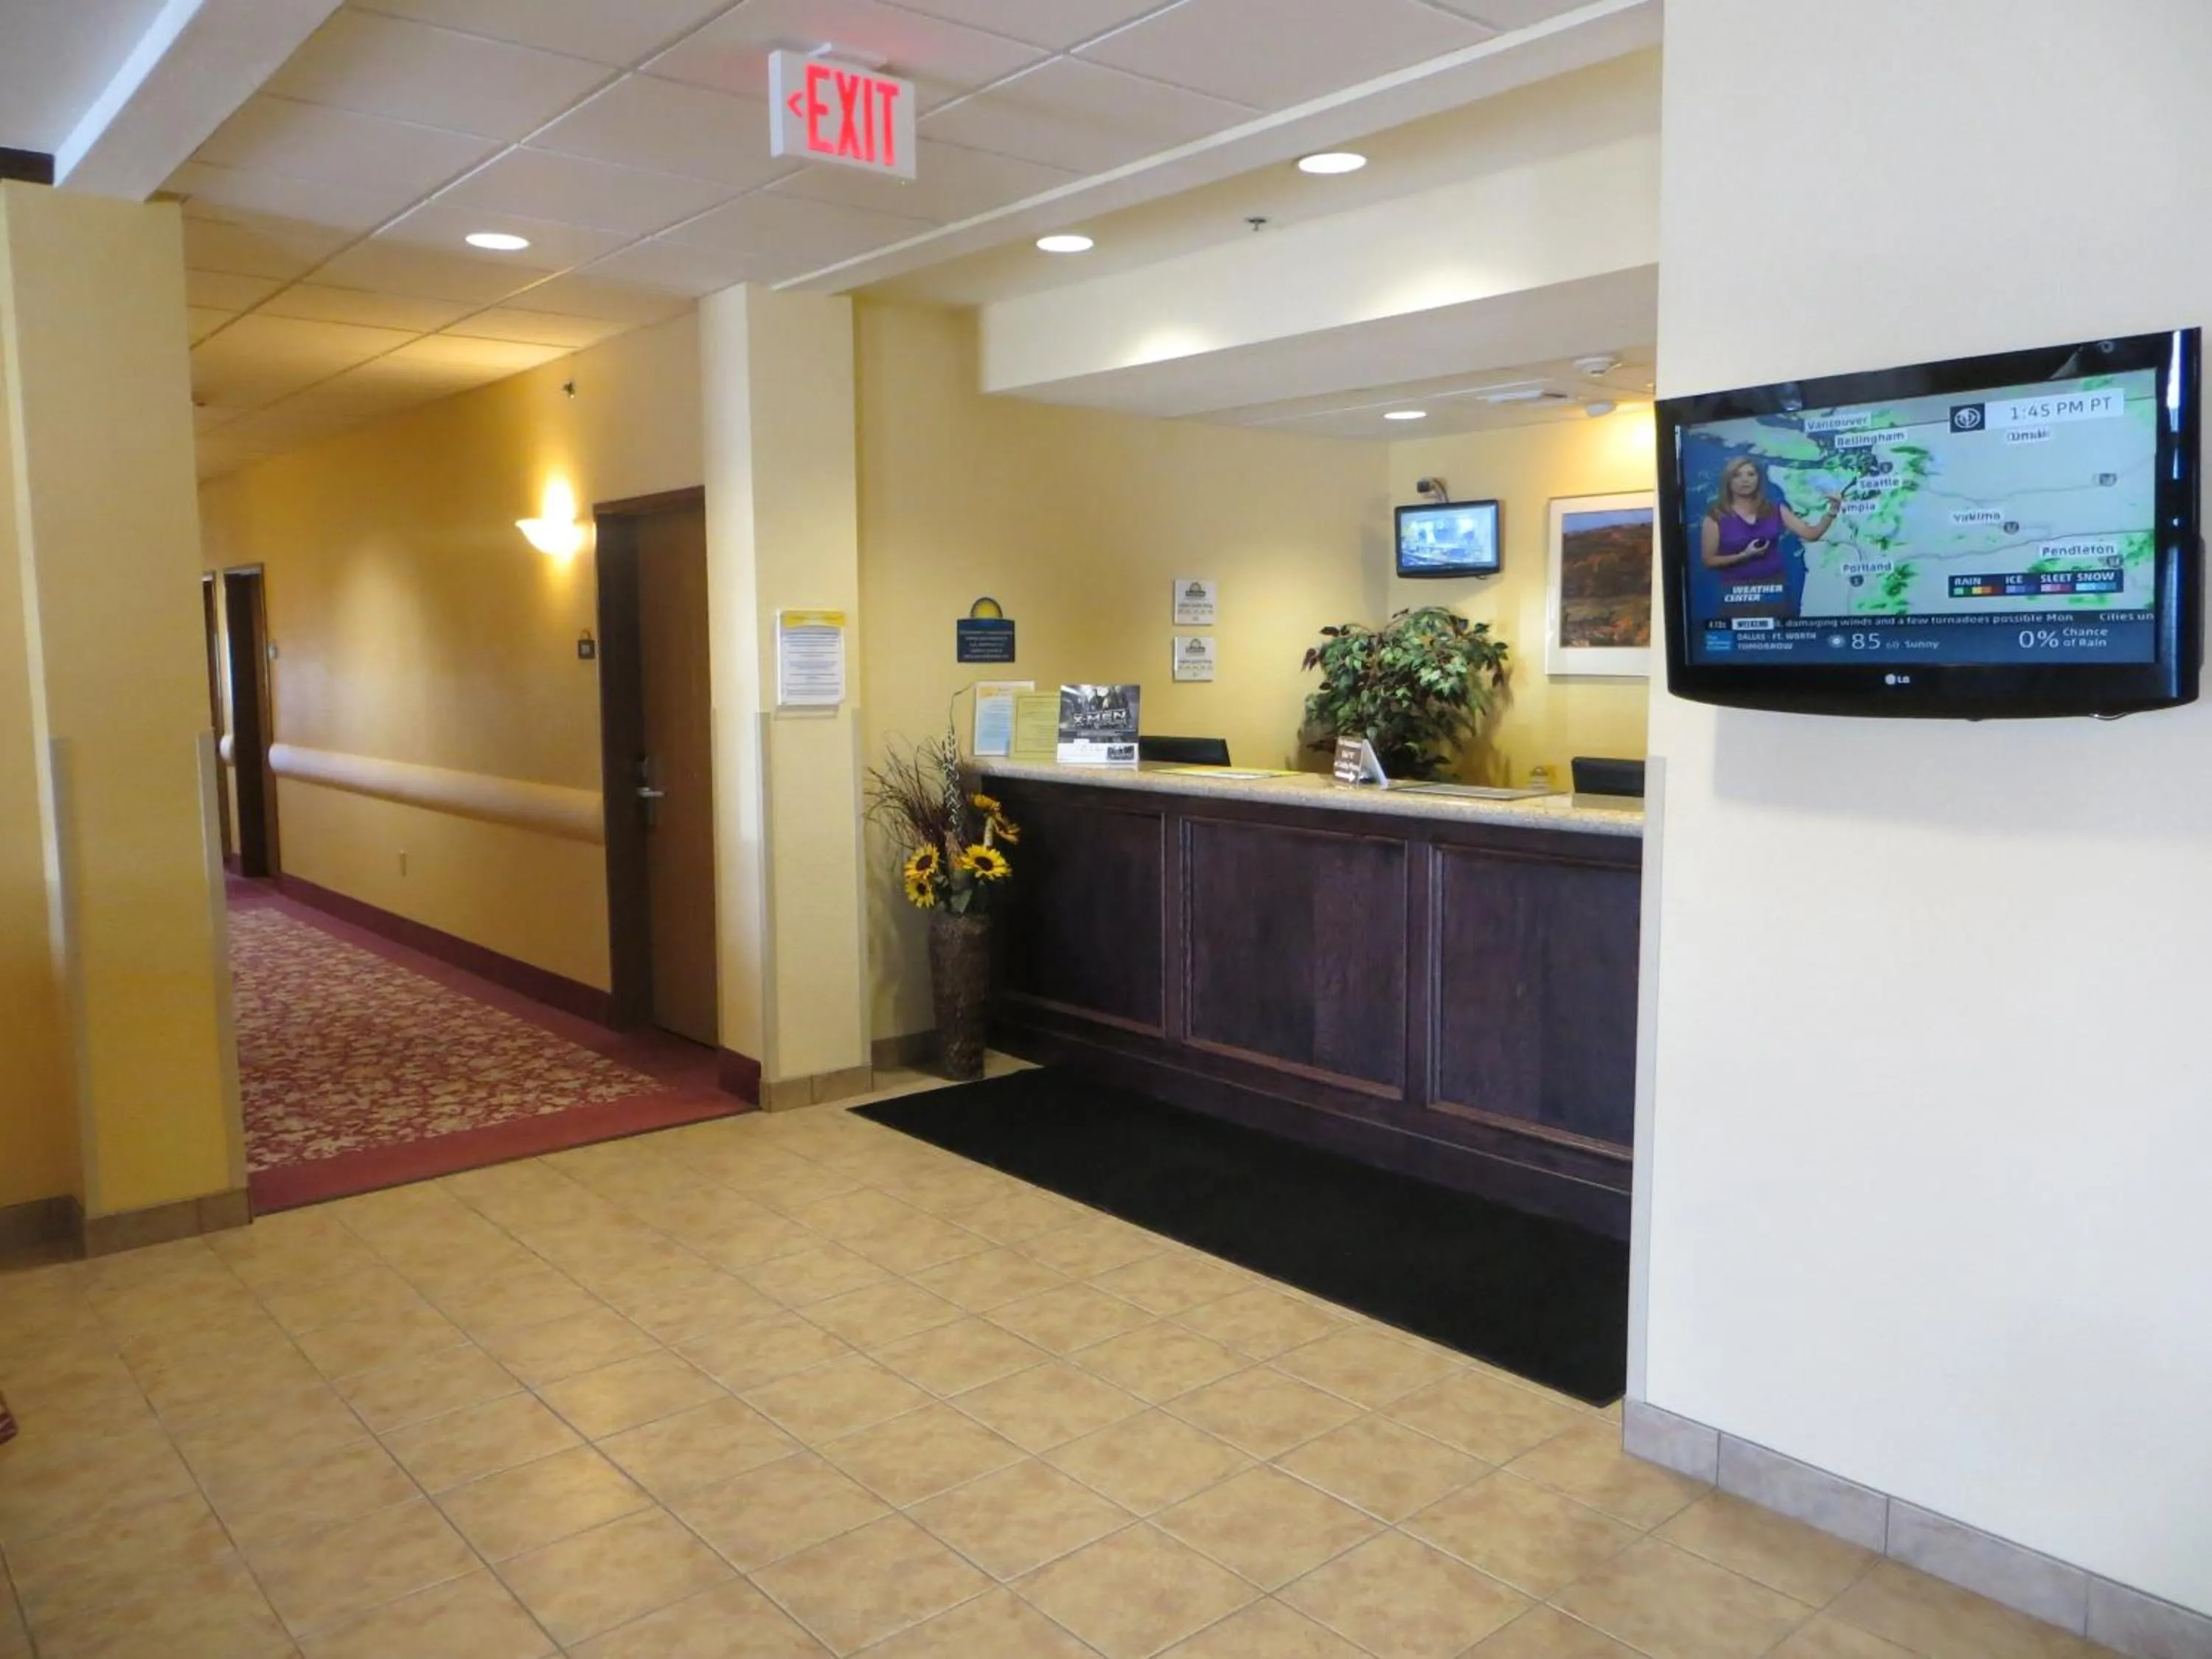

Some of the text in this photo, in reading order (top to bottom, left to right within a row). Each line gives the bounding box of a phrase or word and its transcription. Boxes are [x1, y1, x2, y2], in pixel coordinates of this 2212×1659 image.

[804, 62, 901, 167] EXIT
[2011, 396, 2112, 420] 1:45 PM PT
[1807, 415, 1868, 431] Vancouver
[1837, 431, 1905, 447] Bellingham
[1860, 478, 1900, 490] Seattle
[1952, 511, 2000, 524] Yakima
[2042, 543, 2115, 557] Pendleton
[1843, 561, 1893, 573] Portland
[1954, 571, 2115, 585] RAIN ICE SLEET SNOW
[1732, 584, 1784, 594] WEATHER
[1724, 593, 1761, 602] CENTER
[2046, 613, 2074, 622] Mon
[2098, 612, 2136, 622] Cities
[1851, 633, 1882, 650] 85
[1905, 640, 1941, 651] Sunny
[2018, 627, 2110, 649] 0% Chance
[2062, 637, 2108, 647] of Rain
